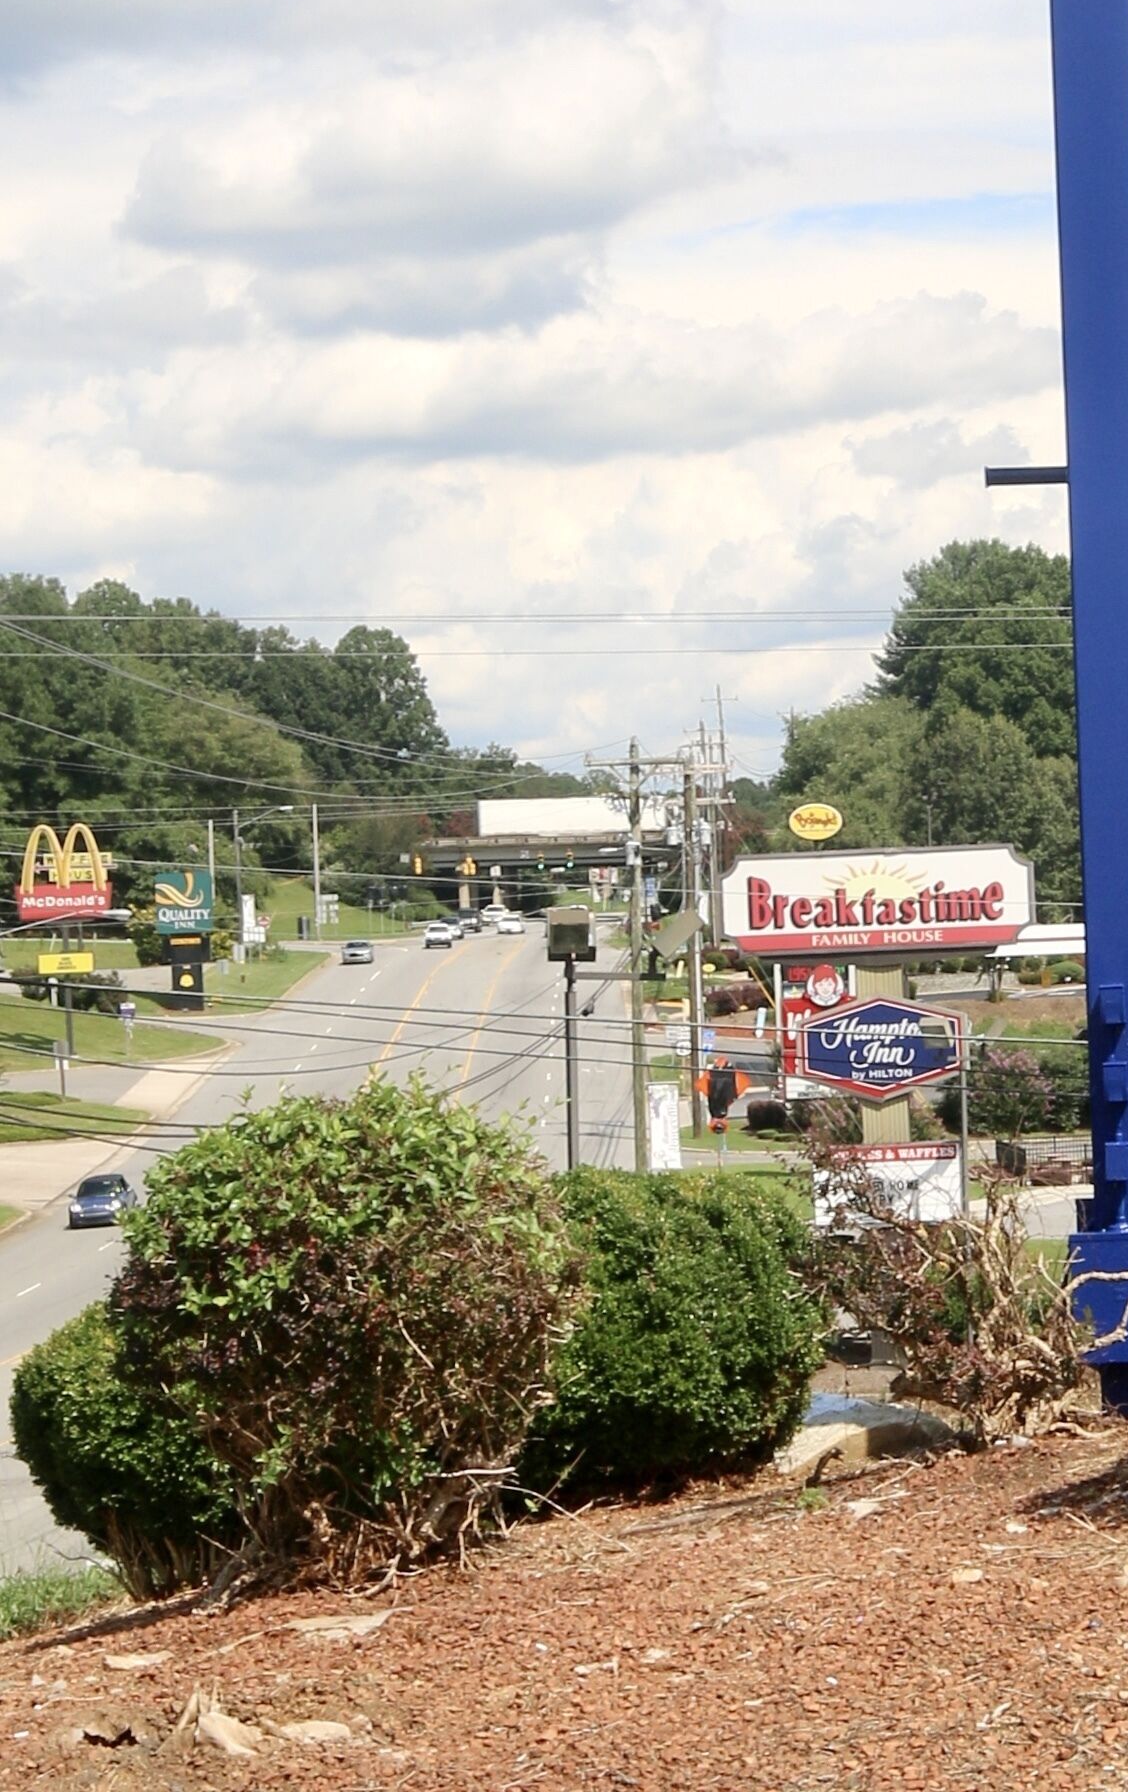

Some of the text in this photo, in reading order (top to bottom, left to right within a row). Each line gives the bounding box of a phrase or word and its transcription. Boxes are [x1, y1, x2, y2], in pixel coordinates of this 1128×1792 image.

[22, 895, 106, 908] McDonald's
[747, 876, 1004, 929] Breakfastime
[158, 908, 210, 922] QUALITY
[174, 921, 196, 929] INN
[811, 930, 944, 947] FAMILY HOUSE
[820, 1017, 922, 1049] Hampto
[850, 1041, 915, 1068] Inn
[851, 1068, 913, 1081] by HILTON
[884, 1149, 895, 1160] &
[897, 1146, 956, 1159] WAFFLES
